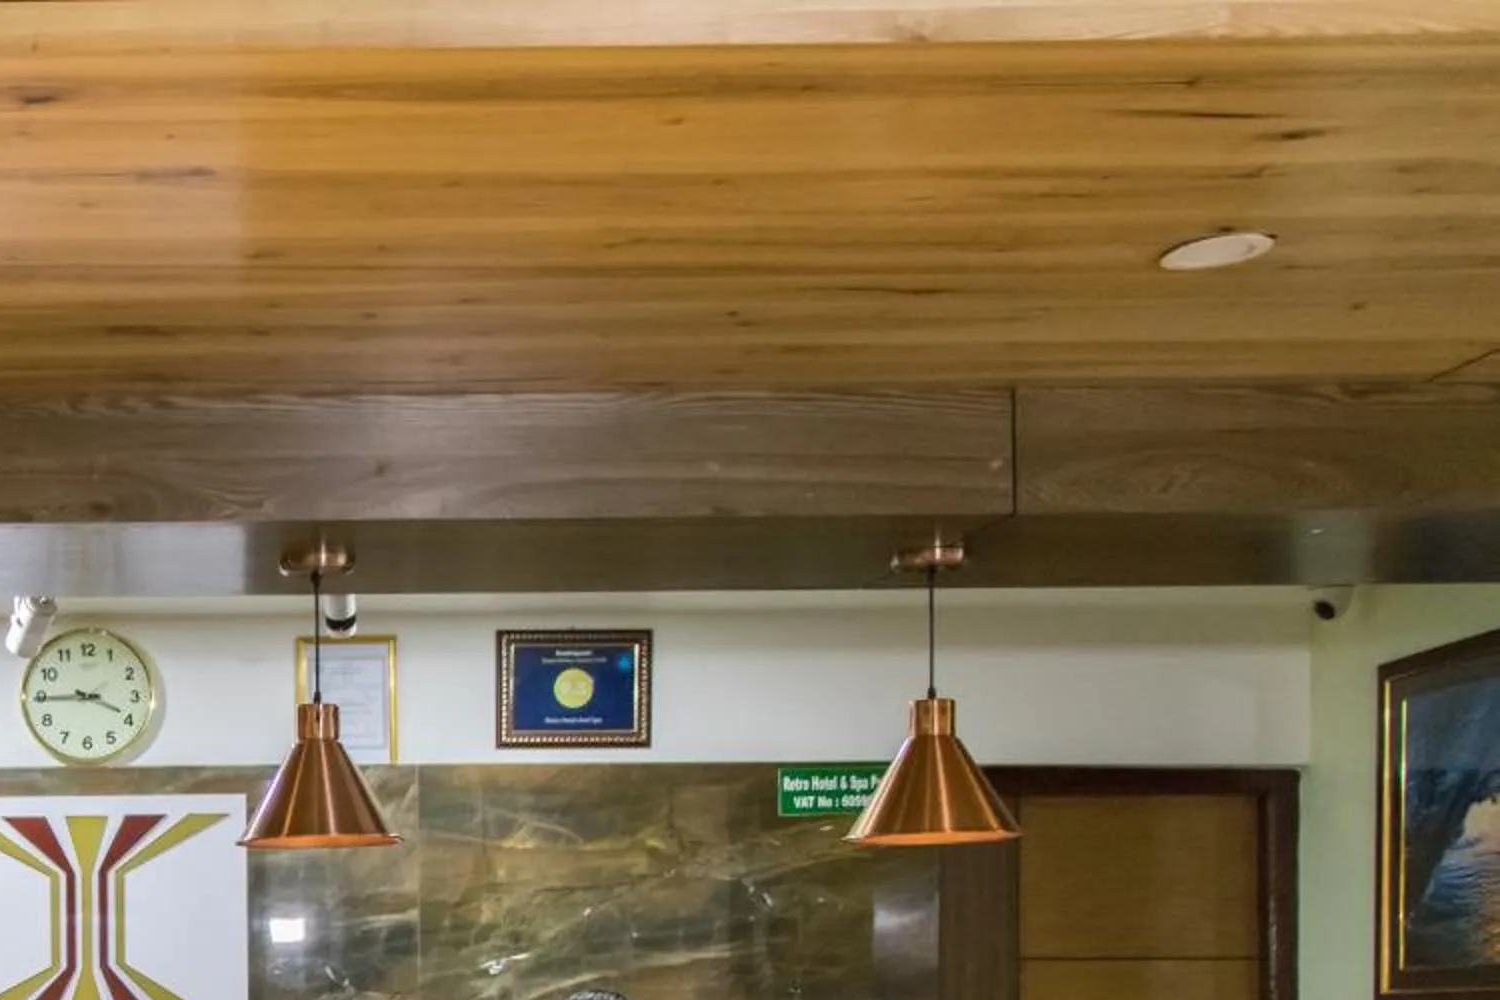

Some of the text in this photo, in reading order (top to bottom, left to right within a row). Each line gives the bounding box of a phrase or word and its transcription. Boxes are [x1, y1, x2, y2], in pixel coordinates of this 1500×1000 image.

[57, 648, 71, 662] 11
[79, 643, 97, 657] 12
[106, 649, 113, 662] 1
[41, 667, 58, 682] 10
[125, 666, 135, 681] 2
[130, 689, 140, 703] 3
[41, 713, 53, 727] 8
[123, 713, 134, 727] 4
[59, 730, 70, 745] 7
[82, 735, 93, 750] 6
[105, 730, 117, 745] 5
